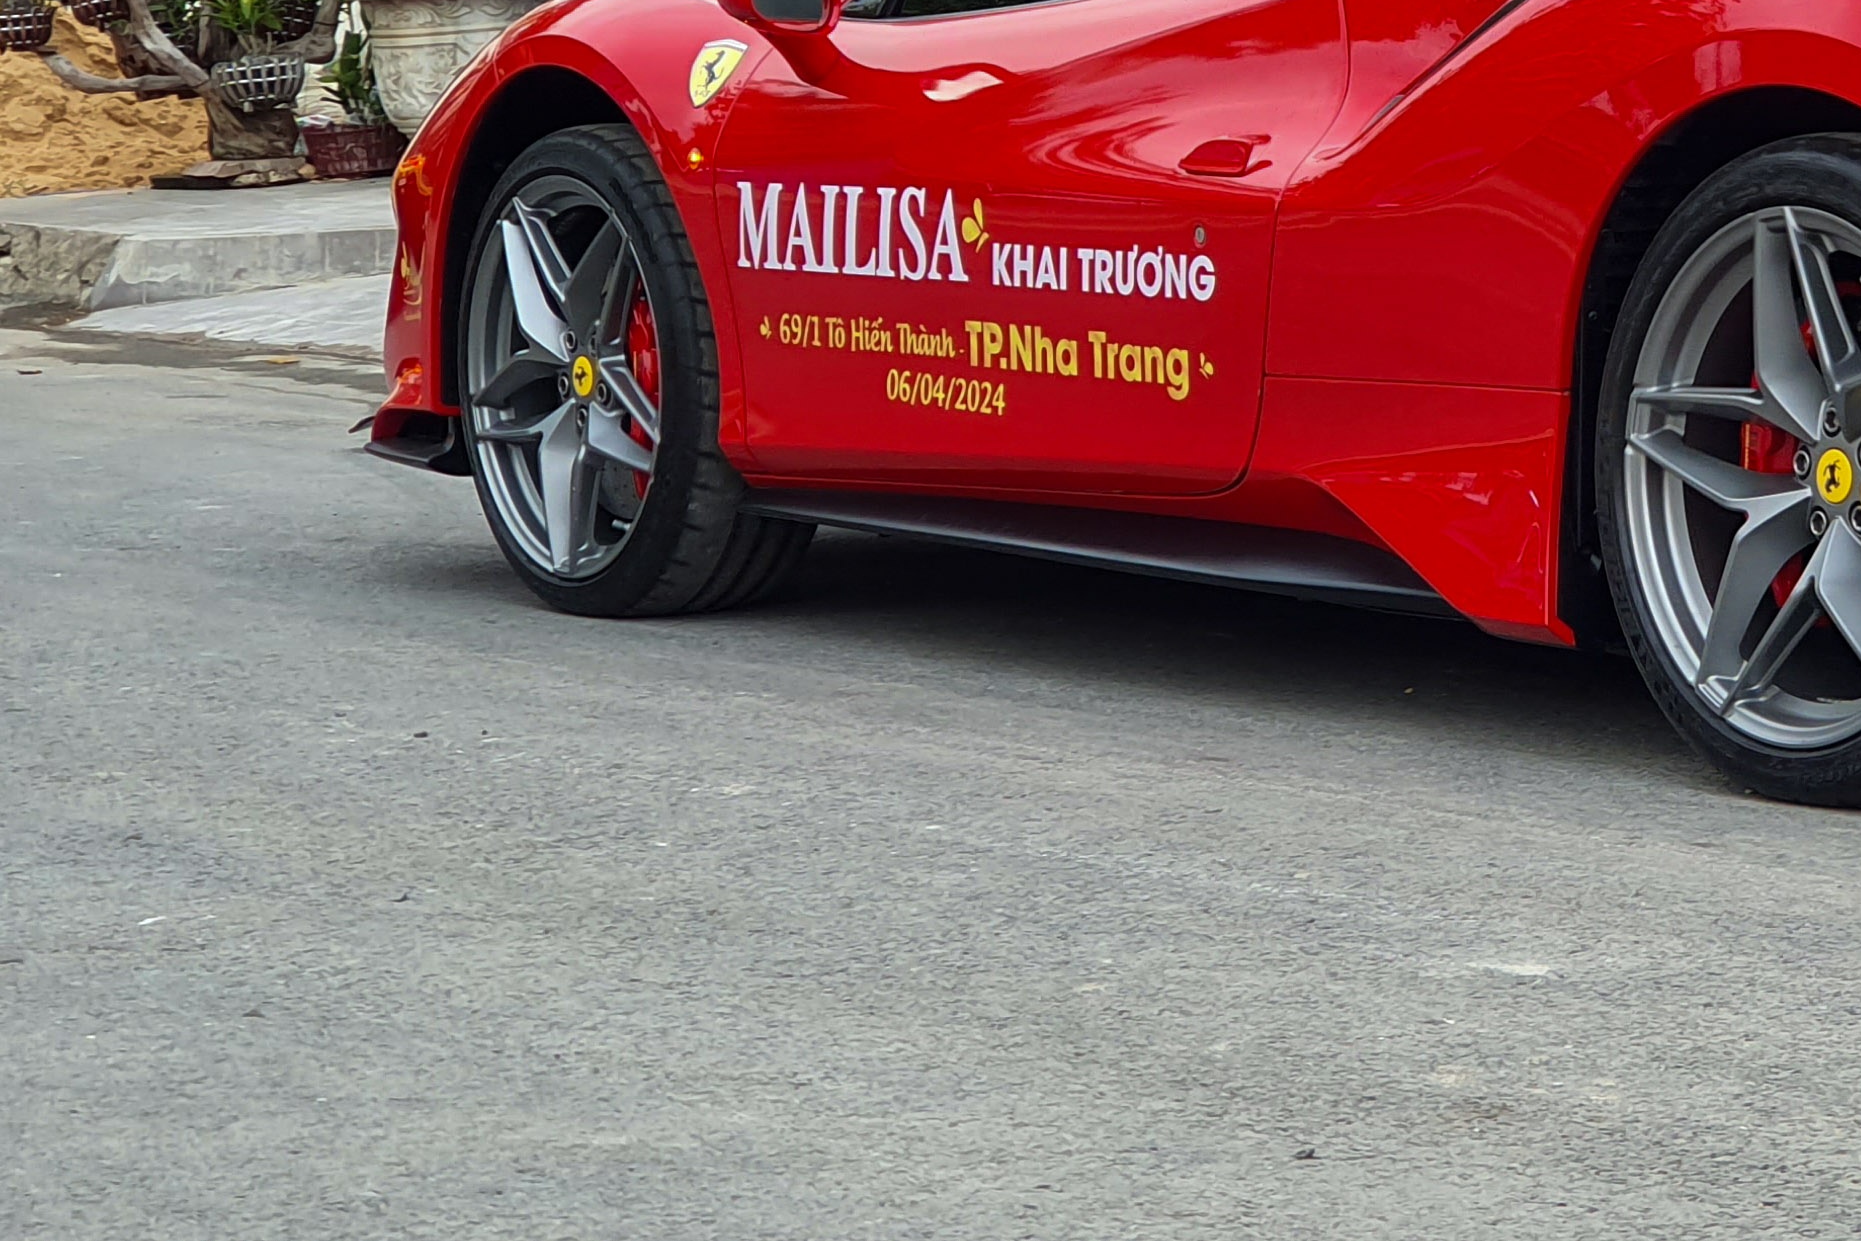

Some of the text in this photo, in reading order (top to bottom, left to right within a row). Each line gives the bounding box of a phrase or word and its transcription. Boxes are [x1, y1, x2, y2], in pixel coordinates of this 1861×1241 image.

[736, 180, 969, 283] MAILISA
[992, 243, 1216, 301] KHAI TRƯƠNG
[779, 313, 822, 348] 69/1
[825, 317, 846, 348] Tô
[850, 316, 893, 353] Hiến
[896, 323, 956, 358] Thành
[965, 320, 1078, 376] TP.Nha
[1088, 330, 1190, 401] Trang
[886, 367, 1006, 416] 06/04/2024
